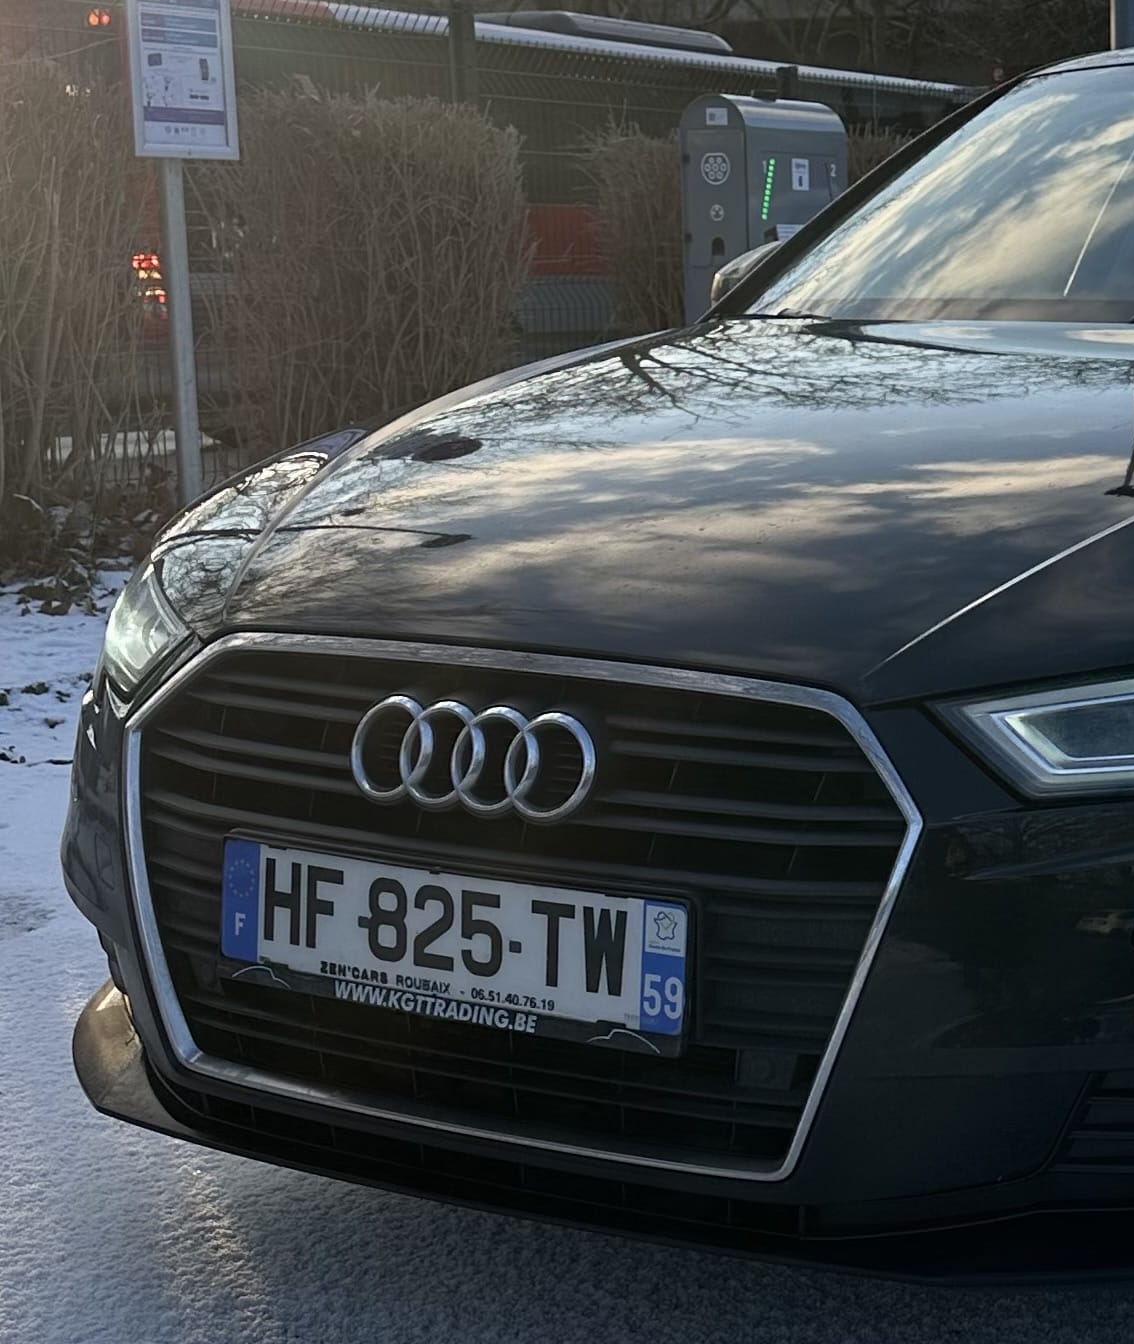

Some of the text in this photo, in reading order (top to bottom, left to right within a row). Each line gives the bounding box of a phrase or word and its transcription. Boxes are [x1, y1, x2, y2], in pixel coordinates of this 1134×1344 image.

[830, 164, 837, 177] 2
[233, 912, 246, 936] F
[320, 960, 388, 985] ZEN'CARS
[396, 974, 452, 996] ROUBAIX
[471, 987, 555, 1011] 06.51.40.76.19
[334, 979, 538, 1034] WWW.KGTTRADING.BE
[642, 973, 684, 1020] 59
